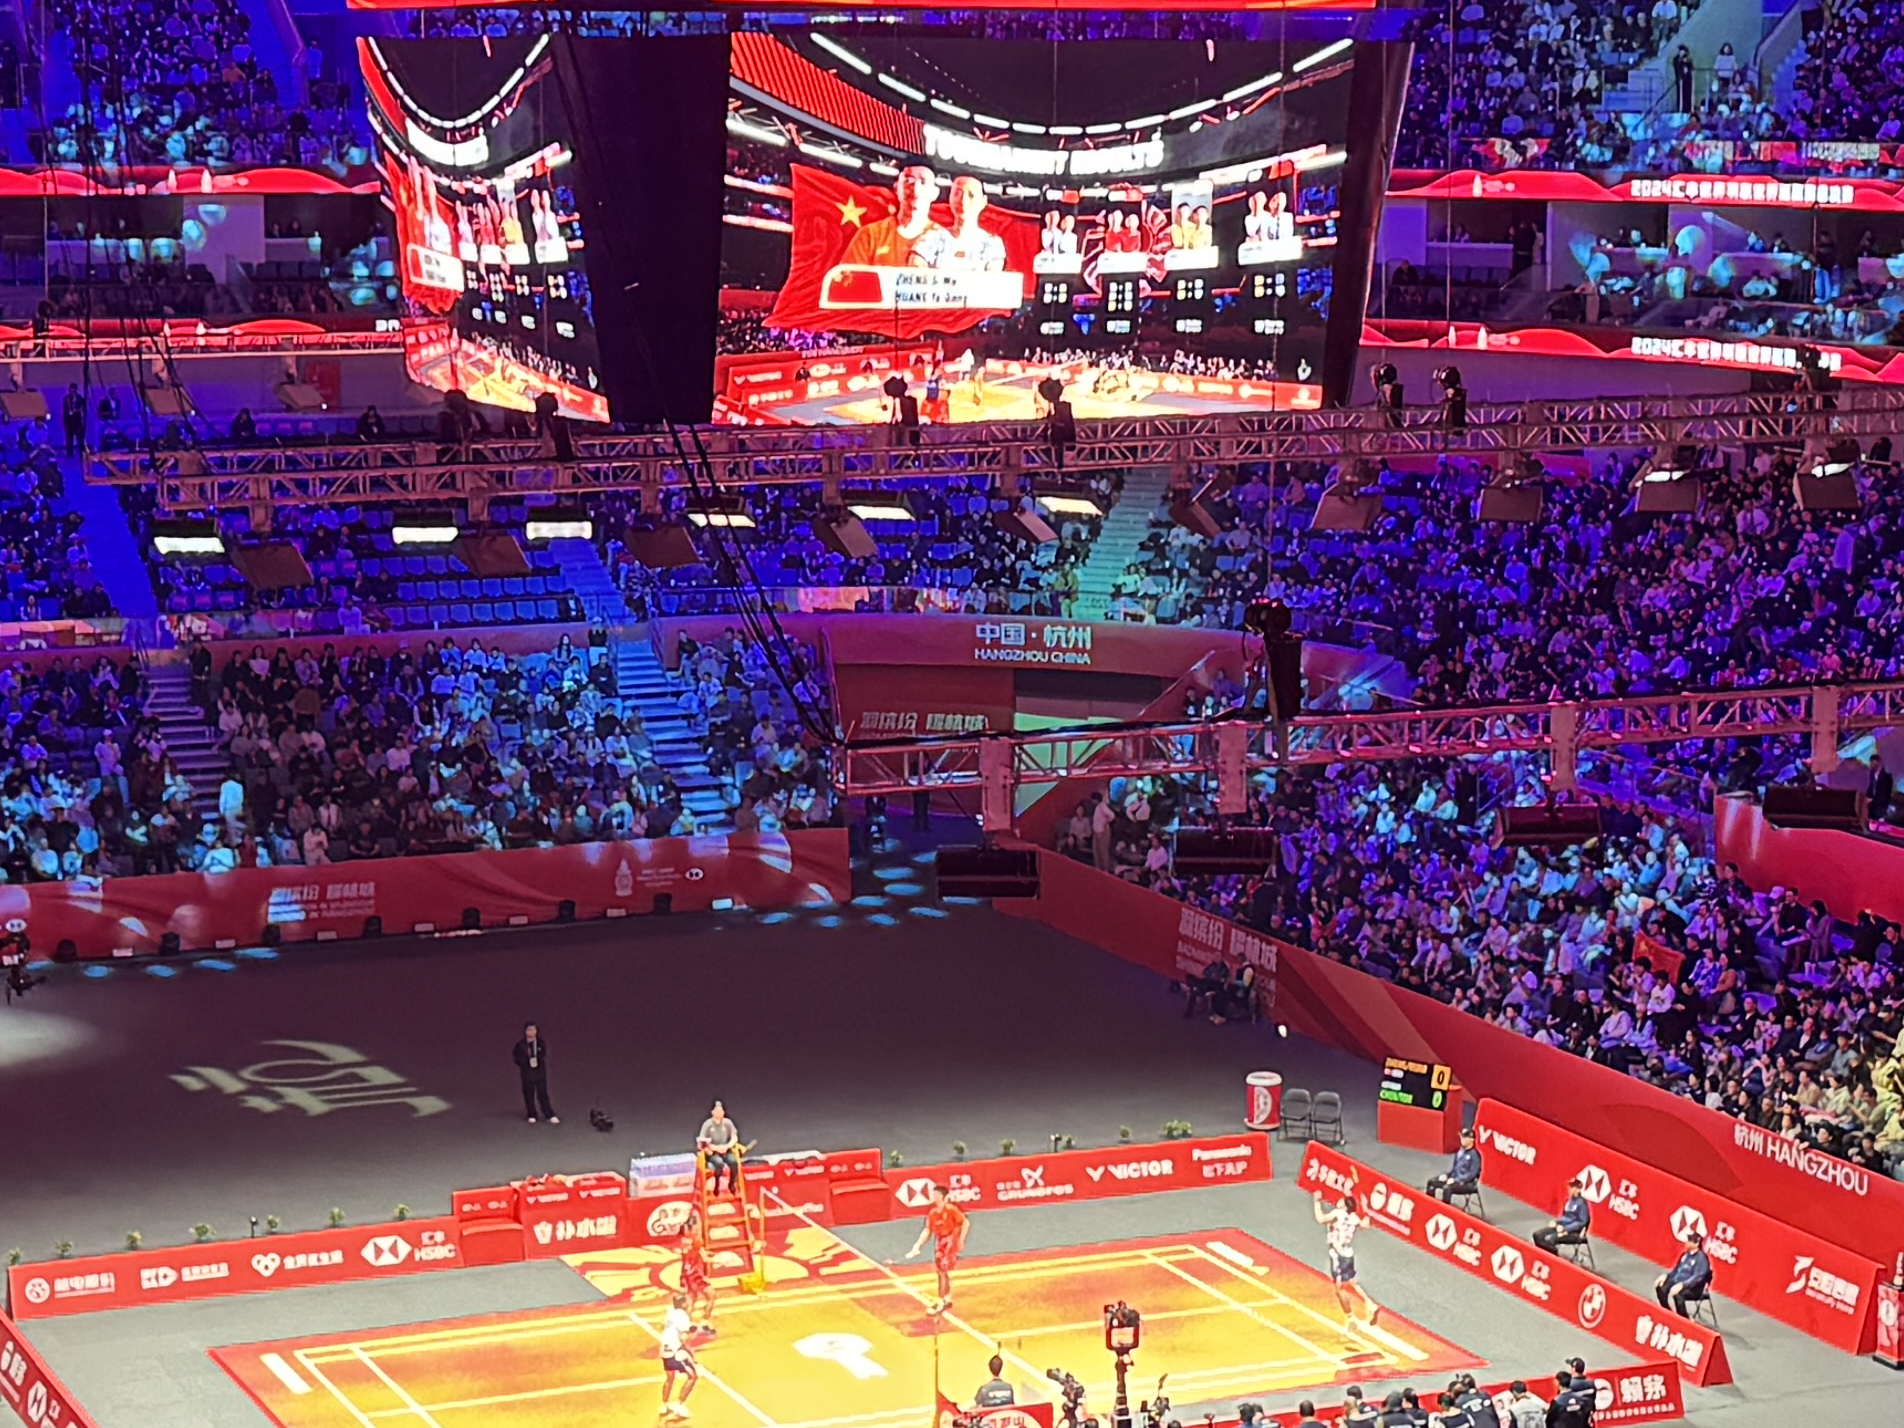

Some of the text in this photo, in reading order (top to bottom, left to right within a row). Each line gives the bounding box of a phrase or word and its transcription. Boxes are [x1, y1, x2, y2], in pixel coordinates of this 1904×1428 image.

[974, 647, 1091, 665] HANGZHOU CHINA
[1436, 1070, 1445, 1086] 0
[1492, 1130, 1537, 1166] VICTOR
[1107, 1159, 1174, 1180] VICTOR
[1733, 1122, 1869, 1196] 杭州 HANGZHOU
[1607, 1193, 1640, 1221] HSBC
[413, 1243, 457, 1262] HSBC
